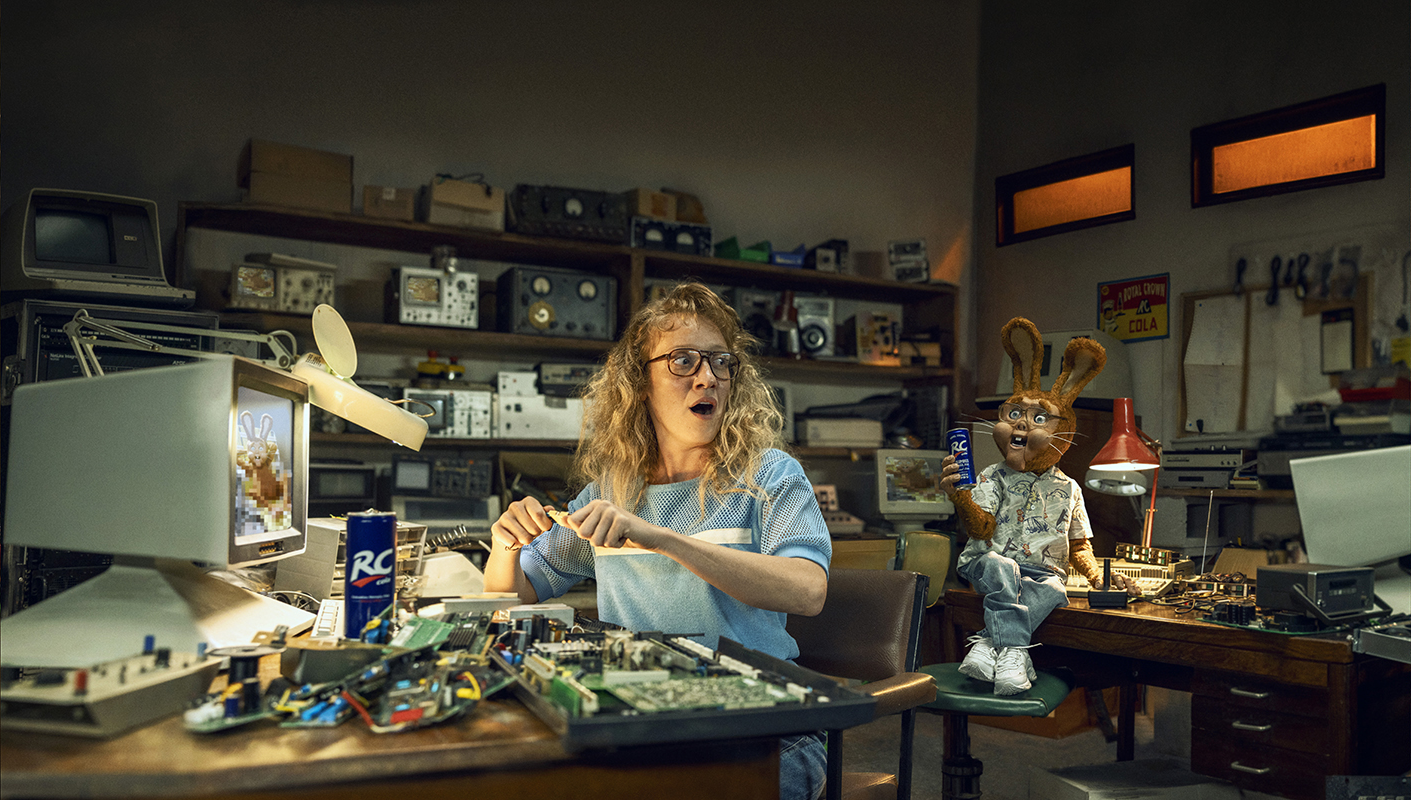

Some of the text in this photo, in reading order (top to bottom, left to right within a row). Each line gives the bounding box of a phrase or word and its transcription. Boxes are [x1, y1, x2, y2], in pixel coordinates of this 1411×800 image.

[1124, 285, 1142, 302] ROYAL
[1143, 283, 1165, 297] CROWN
[1129, 317, 1158, 333] COLA
[951, 440, 968, 456] RC
[350, 548, 393, 583] RC
